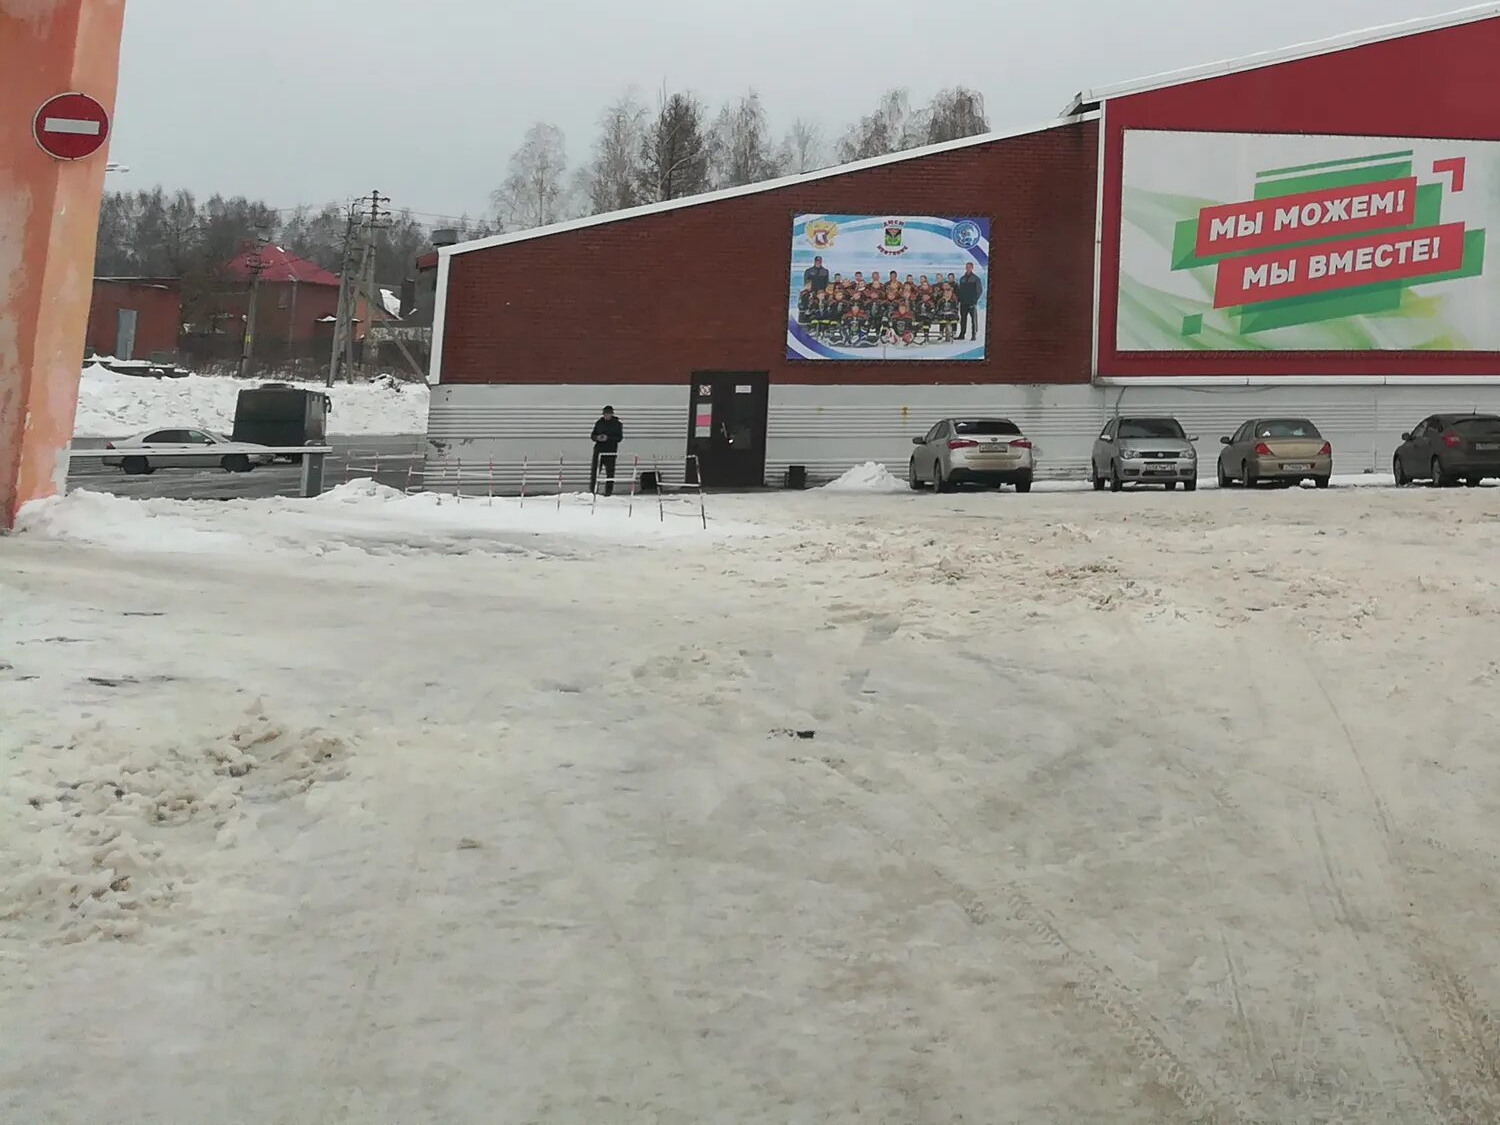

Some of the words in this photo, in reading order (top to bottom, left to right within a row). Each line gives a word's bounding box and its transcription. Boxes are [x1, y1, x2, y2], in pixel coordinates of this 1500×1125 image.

[1210, 211, 1263, 241] МЫ
[1274, 190, 1406, 231] МОЖЕМ!
[1243, 259, 1297, 290] МЫ
[1308, 237, 1441, 279] ВМЕСТЕ!
